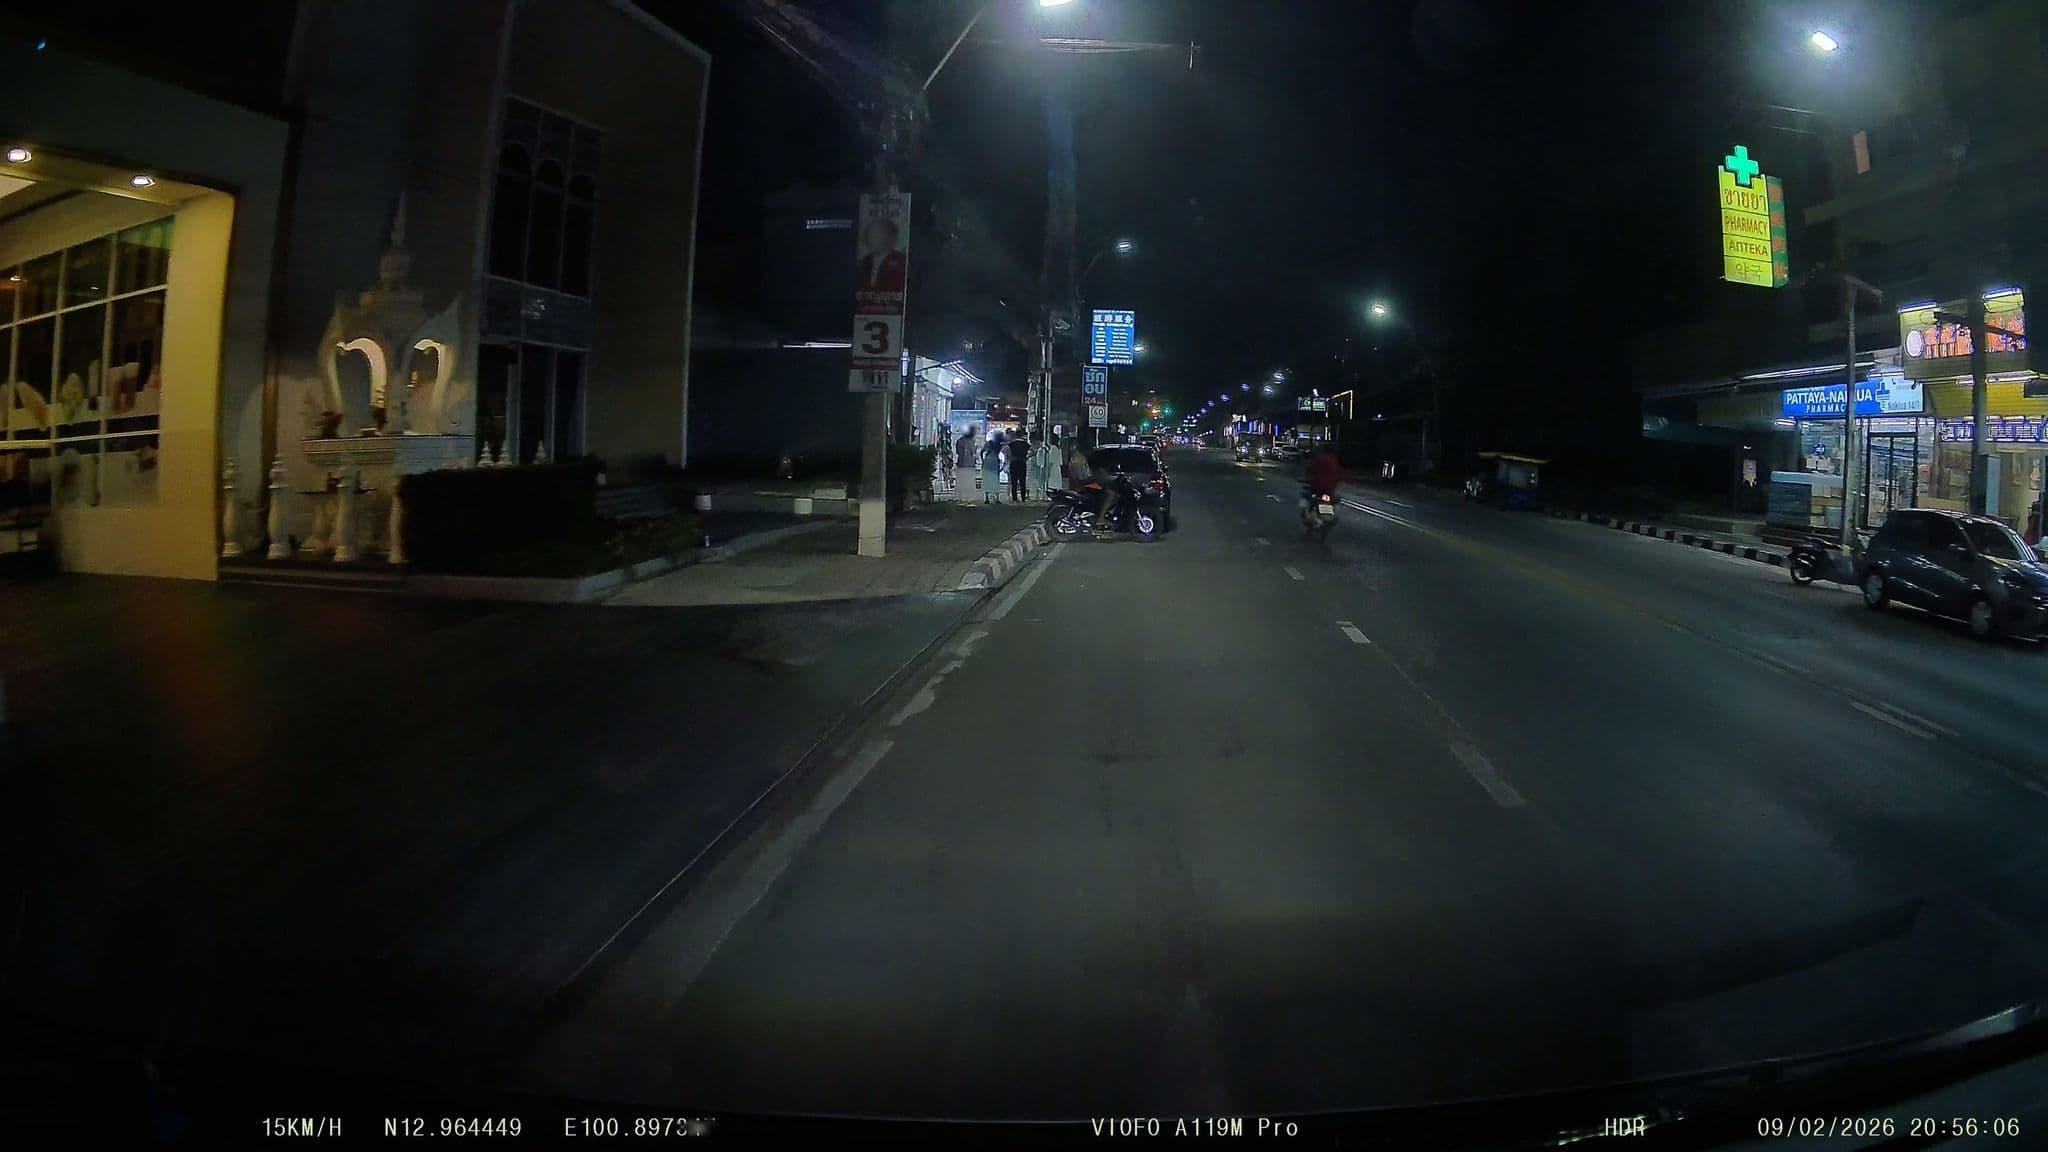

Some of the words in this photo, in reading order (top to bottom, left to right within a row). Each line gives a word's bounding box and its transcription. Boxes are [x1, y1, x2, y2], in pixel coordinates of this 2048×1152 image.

[1724, 189, 1766, 212] ขายยา
[1725, 215, 1769, 236] PHARMACY
[1728, 240, 1769, 257] АПТЕКА
[862, 320, 890, 354] 3
[1787, 388, 1872, 405] PATTAYA-NAUA
[1093, 408, 1104, 416] 60
[1806, 404, 1847, 414] PHARMAC
